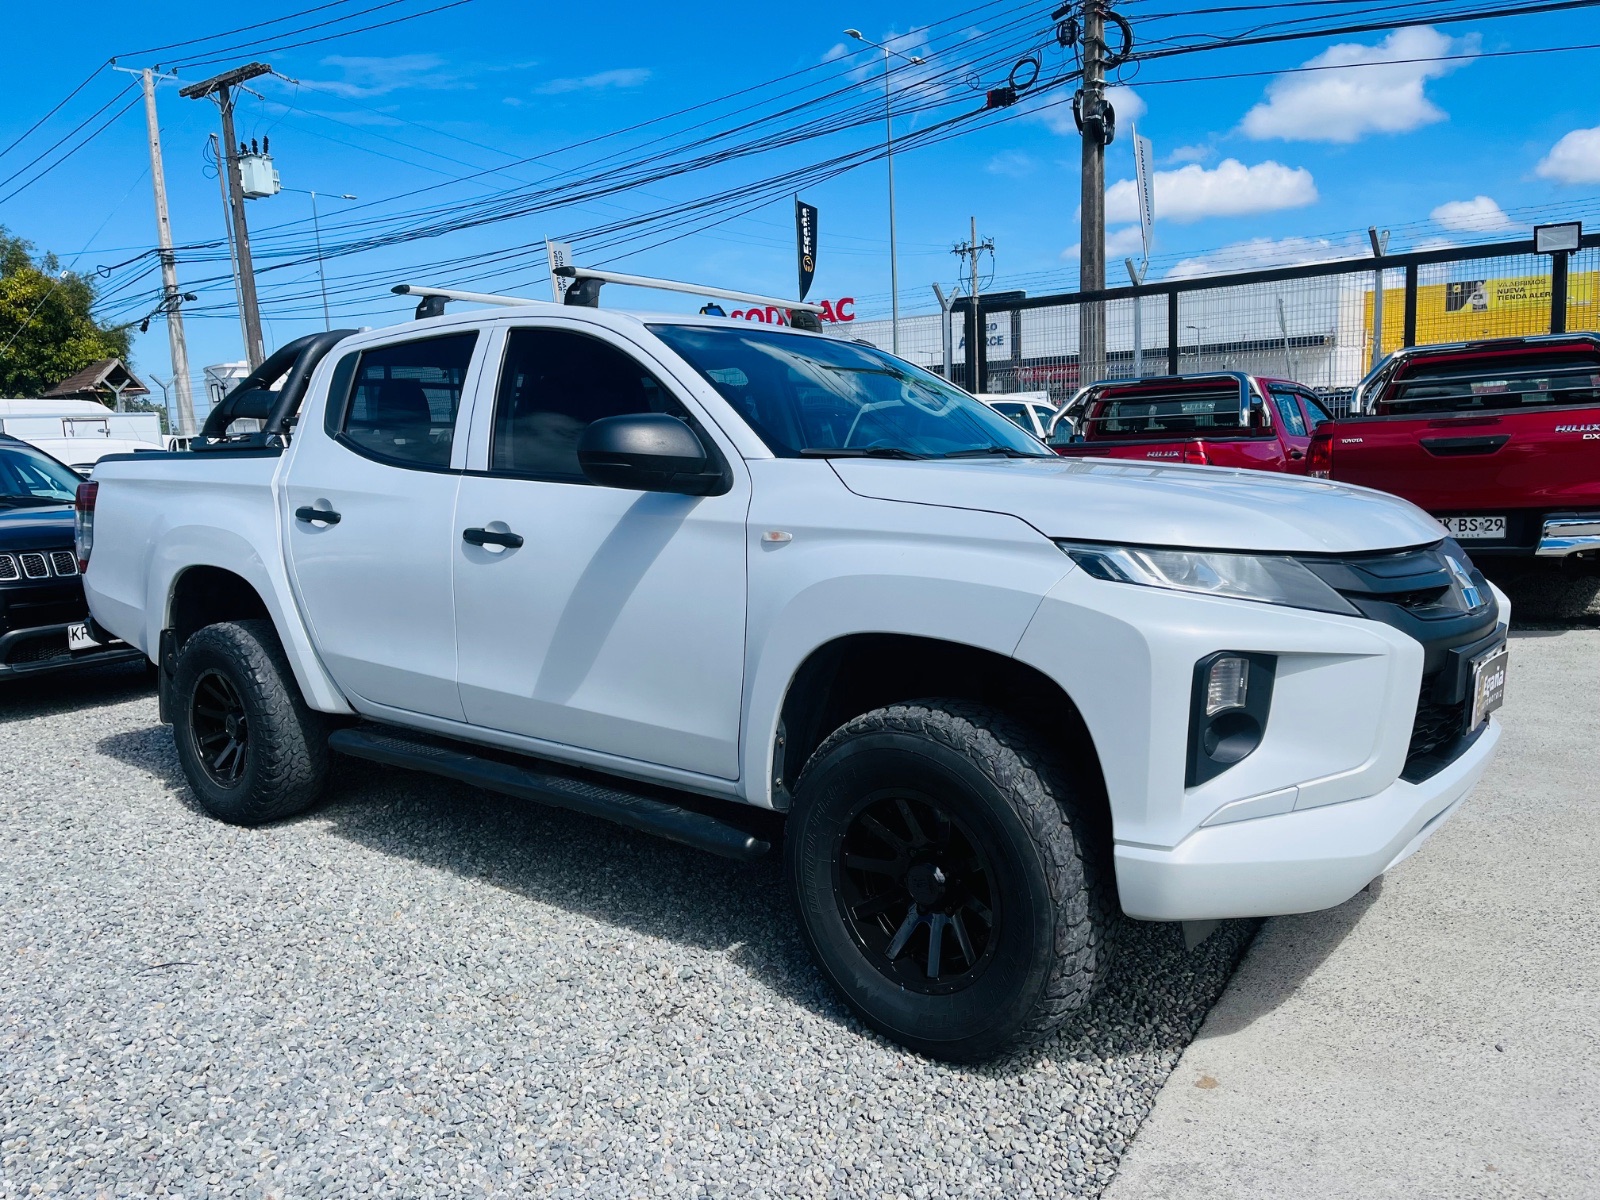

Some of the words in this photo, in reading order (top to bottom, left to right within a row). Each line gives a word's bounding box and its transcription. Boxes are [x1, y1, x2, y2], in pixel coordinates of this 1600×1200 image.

[1139, 140, 1152, 226] FINANCIAMIENTO
[553, 250, 563, 292] VEHILAR
[1508, 279, 1546, 287] ABRIMOS
[1497, 287, 1525, 295] NUEVA
[1529, 291, 1553, 299] ALER
[731, 298, 854, 325] ODAC
[1555, 424, 1600, 432] HILUX
